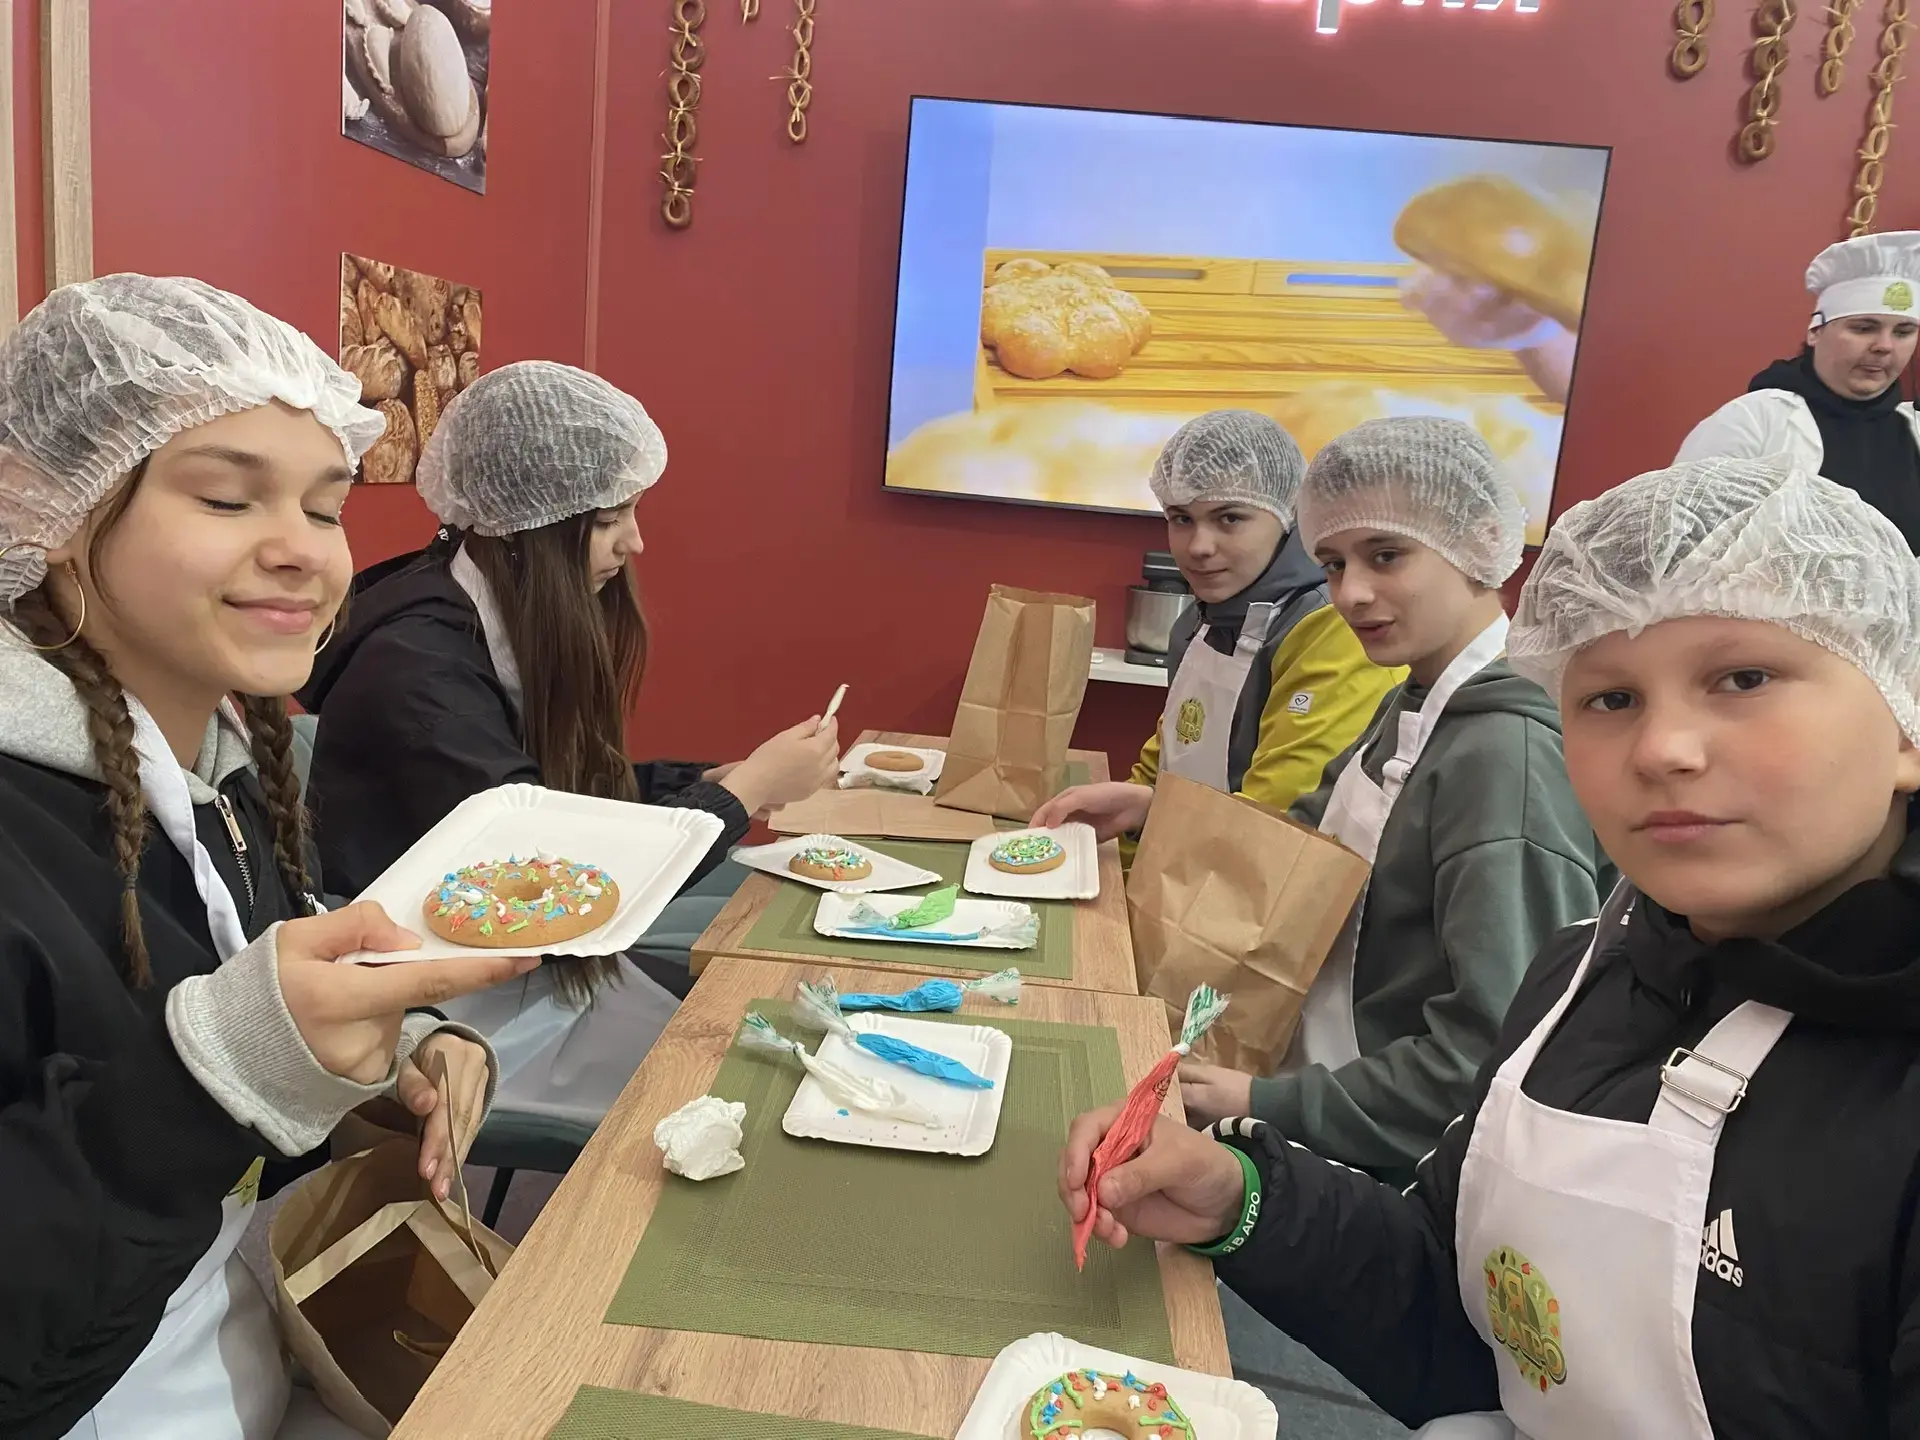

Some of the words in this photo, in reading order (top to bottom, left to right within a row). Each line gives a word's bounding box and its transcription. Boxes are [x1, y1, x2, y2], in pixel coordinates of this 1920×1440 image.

[1222, 1245, 1236, 1253] Я
[1232, 1237, 1245, 1246] В
[1242, 1192, 1260, 1236] АГРО
[1502, 1265, 1531, 1322] Я
[1506, 1314, 1568, 1385] АГРО
